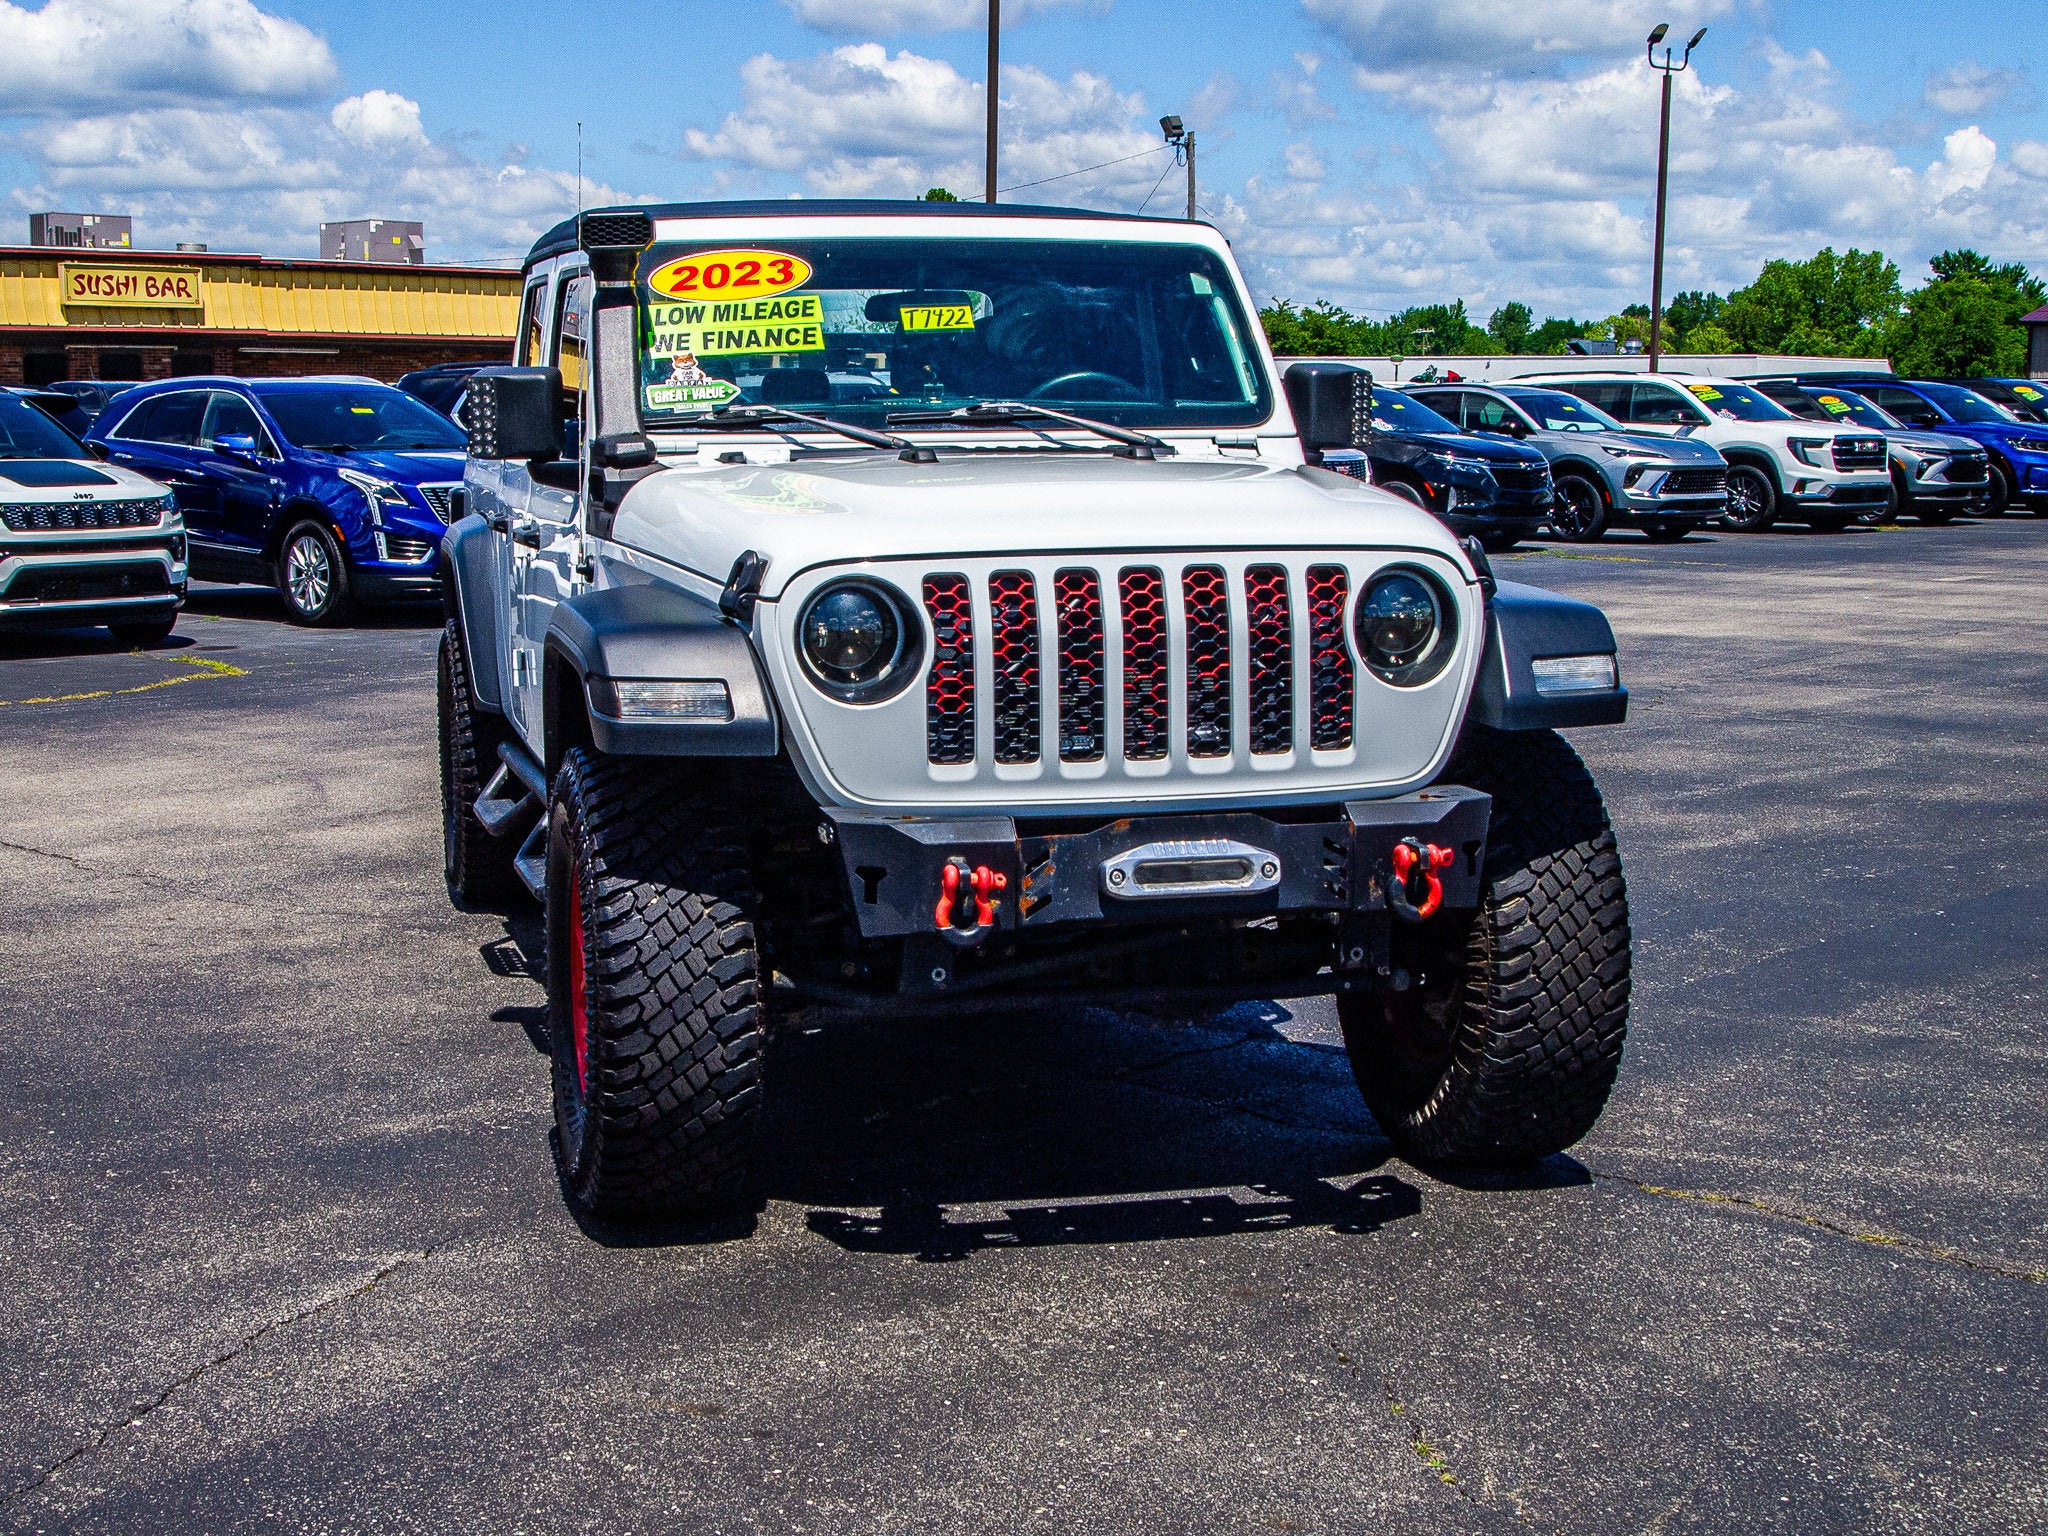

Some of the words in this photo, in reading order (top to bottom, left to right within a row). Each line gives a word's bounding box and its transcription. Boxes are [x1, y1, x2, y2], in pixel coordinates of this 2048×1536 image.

[73, 273, 138, 297] SUSHI
[145, 275, 193, 298] BAR
[669, 258, 795, 293] 2023
[654, 305, 706, 327] LOW
[712, 299, 815, 323] MILEAGE
[904, 308, 969, 329] T7422
[654, 332, 691, 352] WE
[702, 327, 817, 350] FINANCE
[653, 389, 689, 403] GREAT
[692, 386, 726, 401] VALUE
[73, 492, 94, 500] Jeep
